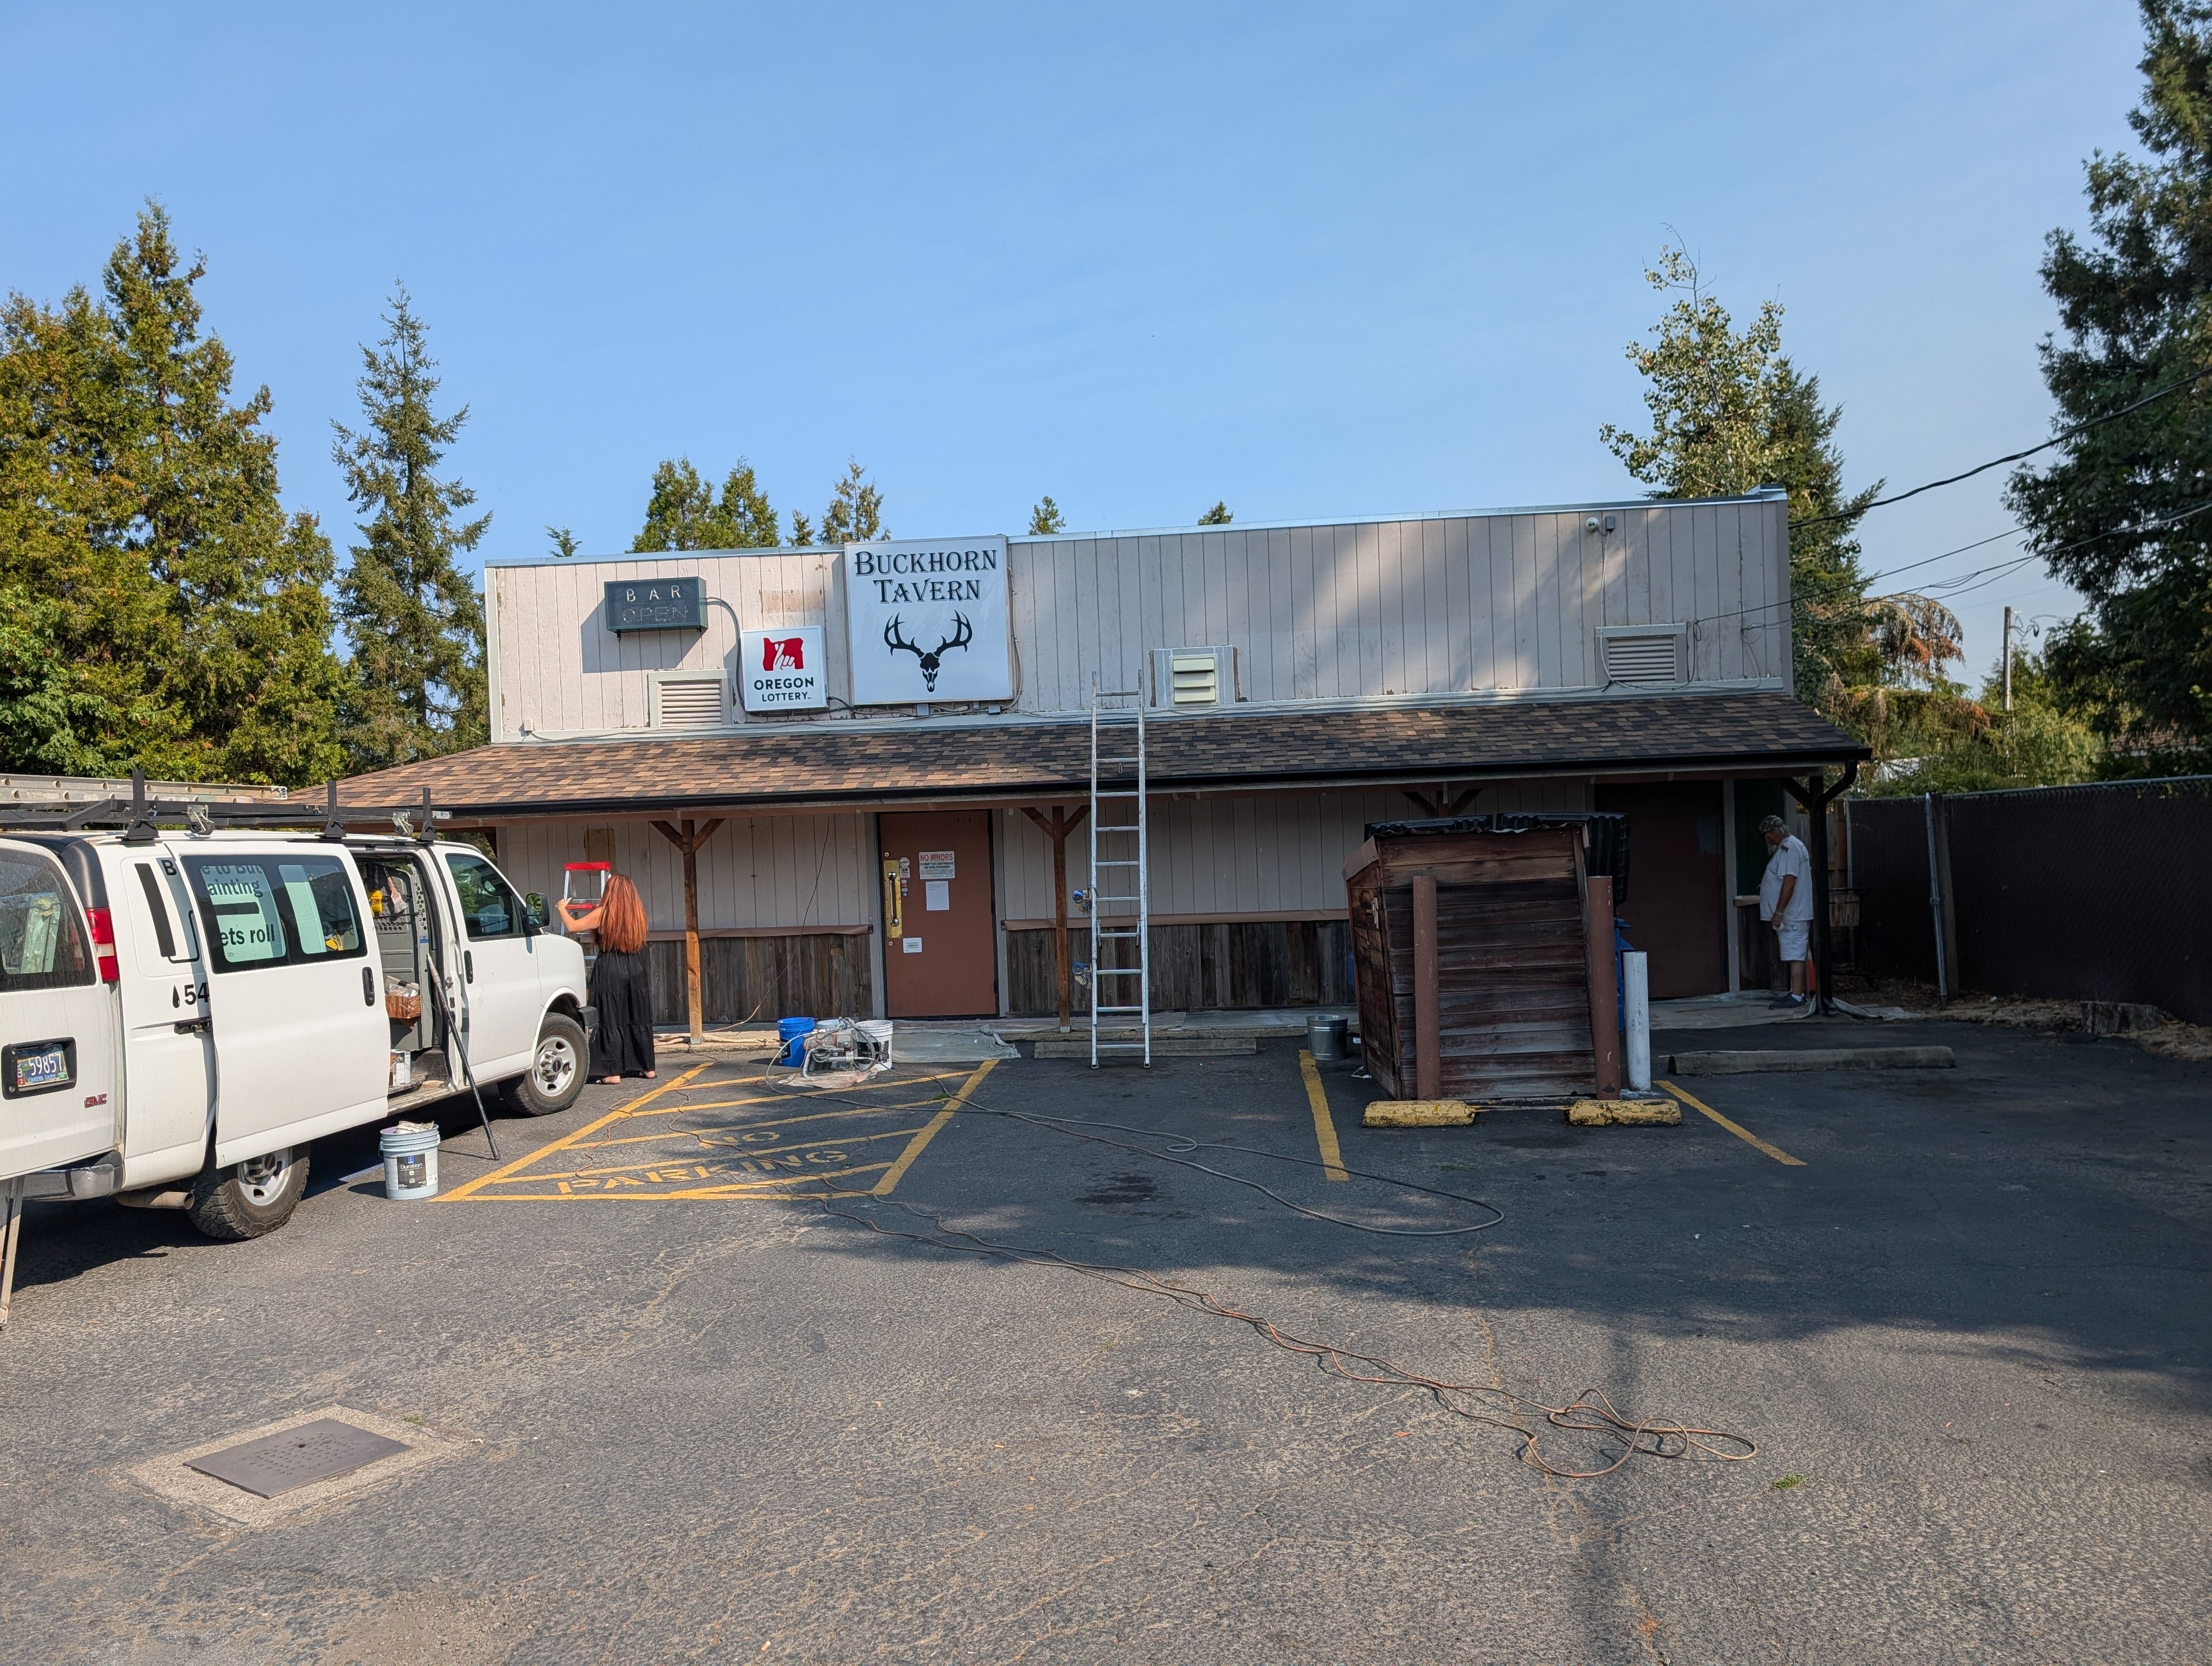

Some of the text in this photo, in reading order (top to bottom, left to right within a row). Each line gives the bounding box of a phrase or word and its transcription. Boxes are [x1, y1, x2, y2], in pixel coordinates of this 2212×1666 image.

[854, 550, 998, 576] BUCKHORN
[626, 585, 681, 603] BAR
[872, 578, 981, 604] TAVERN
[623, 604, 690, 624] OPEN
[754, 676, 814, 690] OREGON
[762, 691, 808, 702] LOTTERY
[207, 878, 263, 898] ainting
[221, 924, 275, 947] ets roll
[29, 1053, 62, 1076] 59857
[85, 1093, 107, 1108] GMC
[557, 1150, 848, 1194] PARKING
